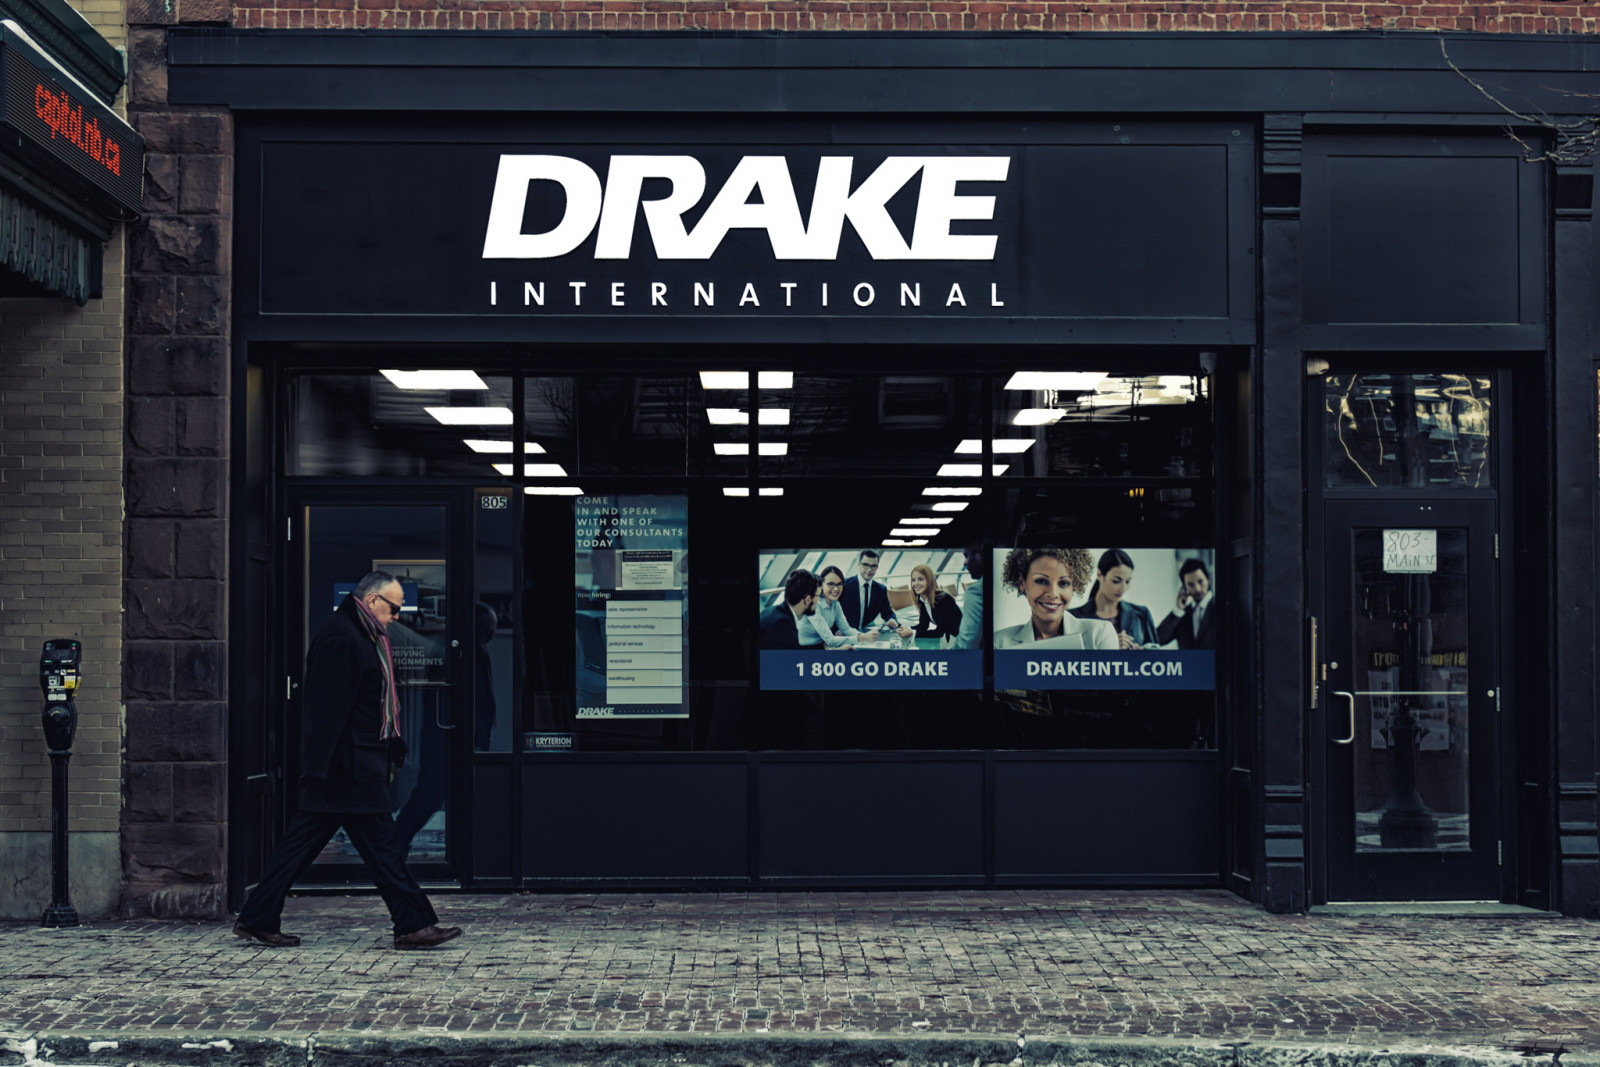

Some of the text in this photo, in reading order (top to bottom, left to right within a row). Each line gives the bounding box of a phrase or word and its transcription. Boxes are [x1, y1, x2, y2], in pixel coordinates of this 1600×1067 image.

[482, 154, 1011, 260] DRAKE
[490, 281, 1004, 307] INTERNATIONAL
[482, 496, 507, 508] 805
[577, 496, 609, 505] COME
[577, 507, 657, 516] IN AND SPEAK
[577, 518, 653, 526] WITH ONE OF
[577, 529, 683, 537] OUR CONSULTANTS
[577, 539, 613, 548] TODAY
[796, 661, 949, 677] 1 800 GO DRAKE
[1026, 661, 1183, 676] DRAKEINTL.COM
[577, 707, 615, 716] DRAKE
[535, 736, 572, 745] KRYTERION
